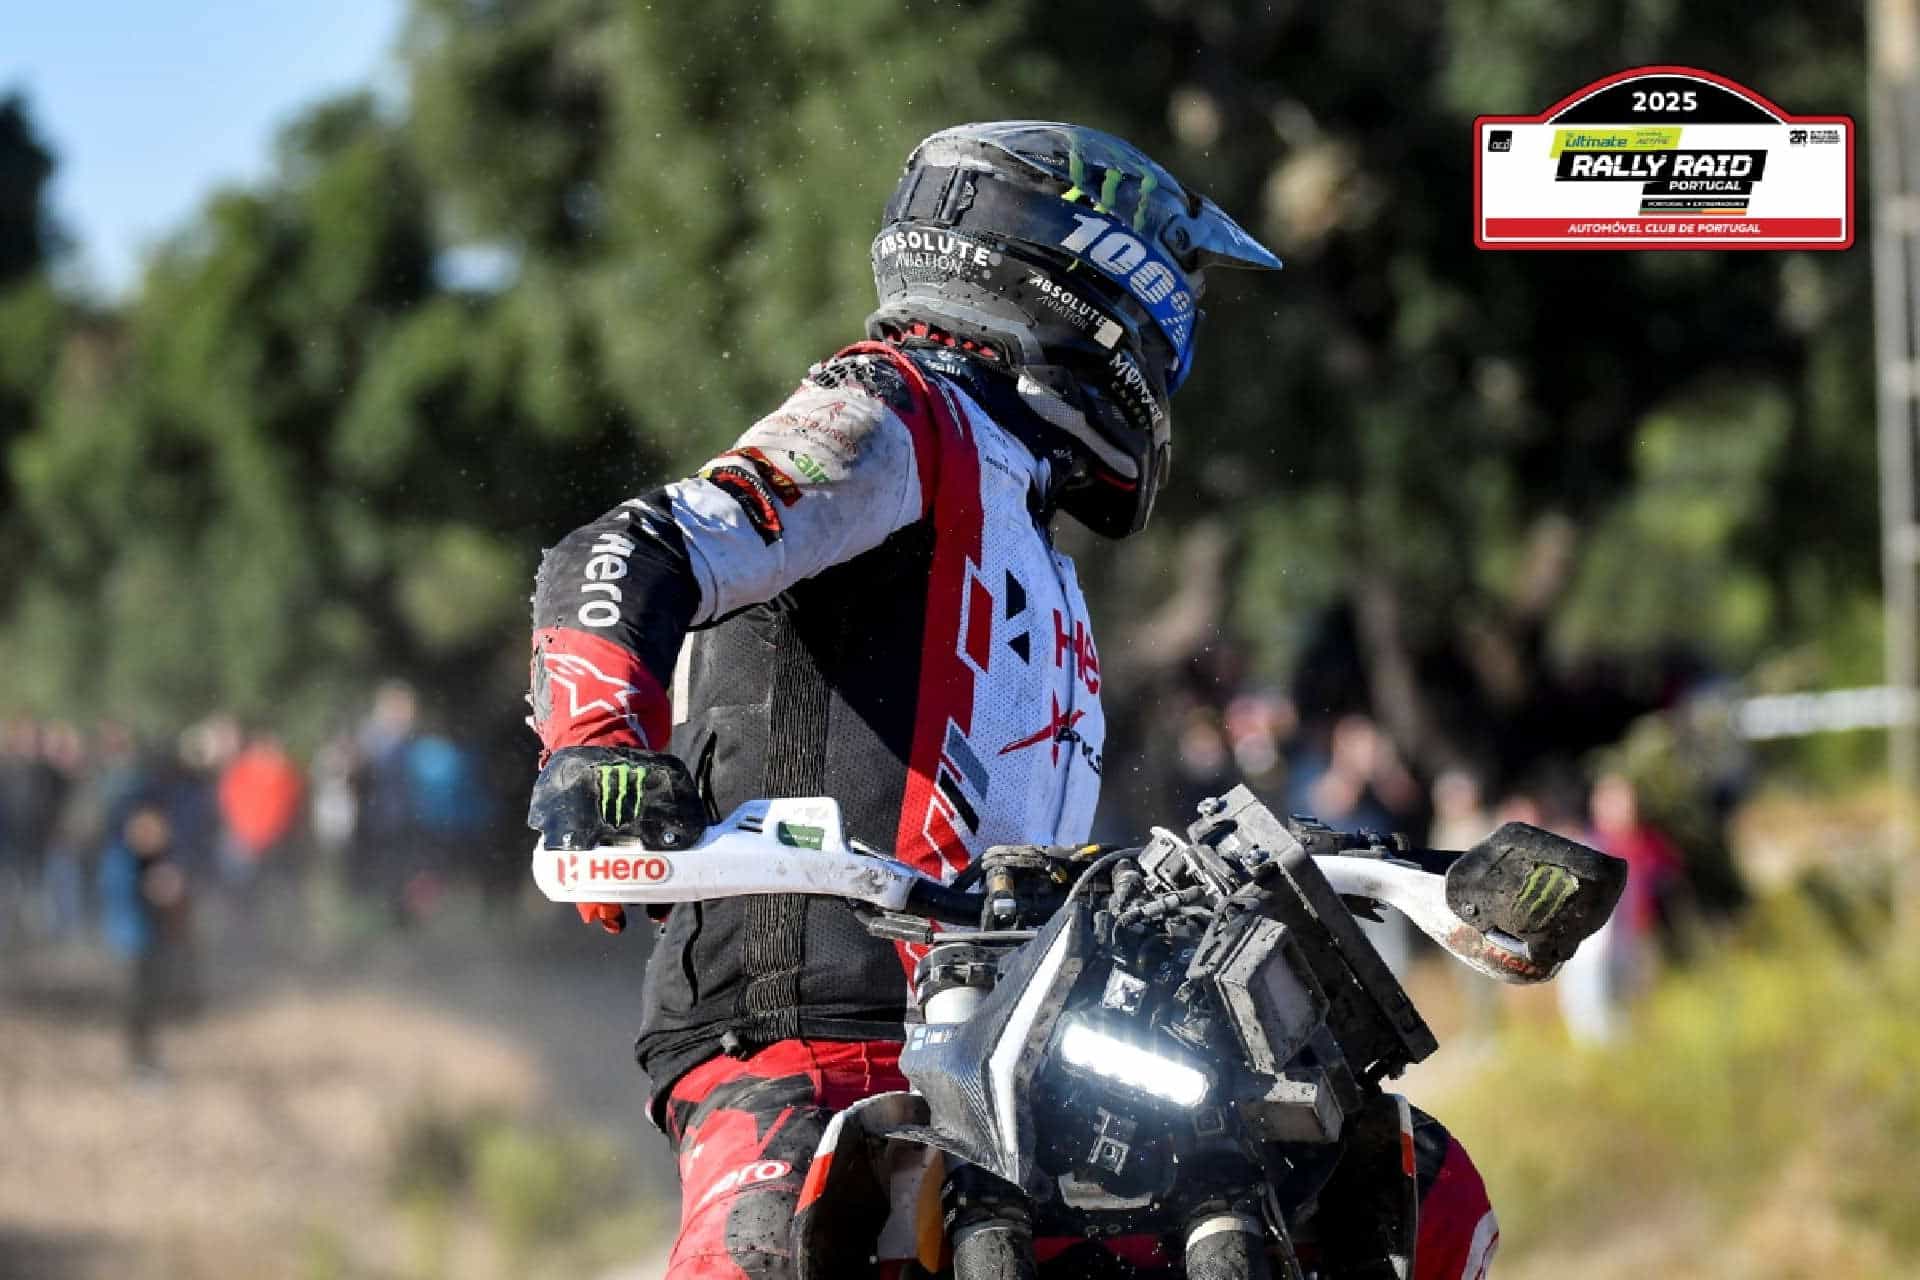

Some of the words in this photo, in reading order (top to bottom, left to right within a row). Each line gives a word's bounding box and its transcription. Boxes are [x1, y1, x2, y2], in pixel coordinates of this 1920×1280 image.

[881, 231, 991, 267] ABSOLUTE
[1028, 269, 1106, 328] ABSOLUTE
[577, 533, 636, 628] Hero
[589, 857, 666, 881] Hero
